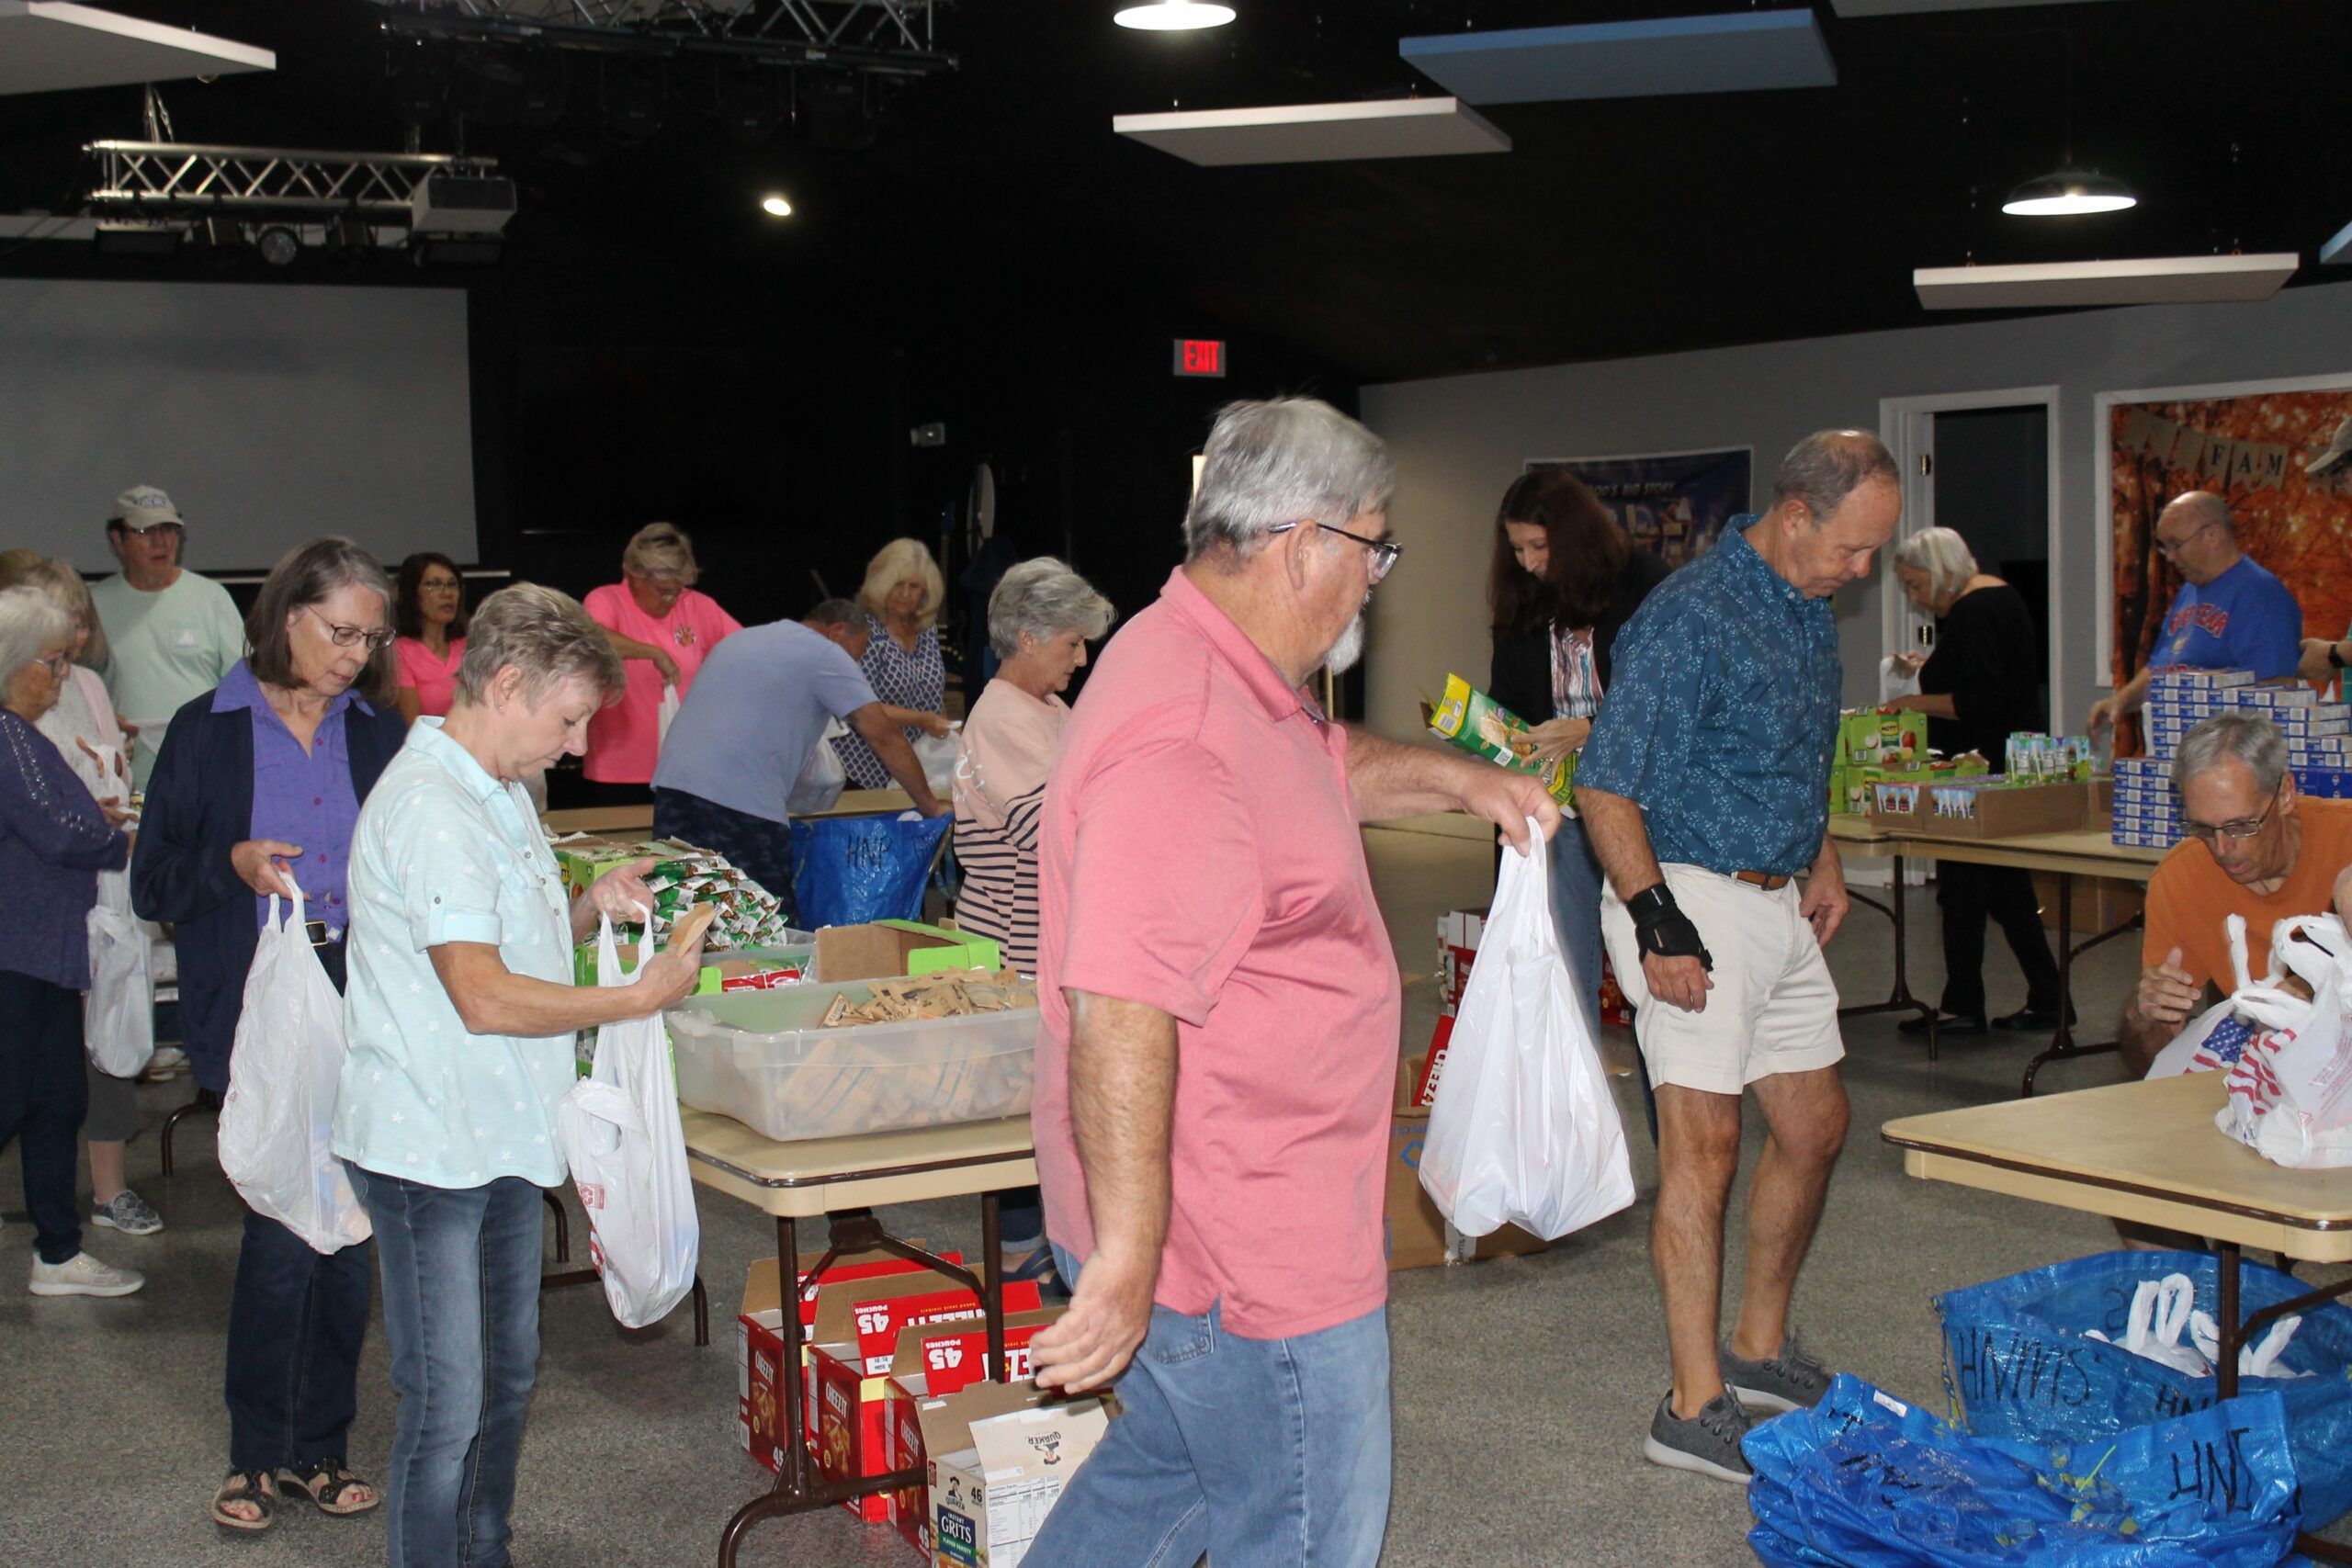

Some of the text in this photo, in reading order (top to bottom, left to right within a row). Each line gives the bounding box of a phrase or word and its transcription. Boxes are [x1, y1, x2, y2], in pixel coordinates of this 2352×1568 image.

[1183, 339, 1220, 373] EXIT
[846, 834, 892, 870] HNP
[857, 1313, 889, 1335] 45
[928, 1347, 963, 1371] 45
[1028, 1431, 1061, 1445] QUAKER
[945, 1495, 966, 1511] QUAKER
[971, 1486, 982, 1503] 46
[919, 1524, 930, 1550] 45
[941, 1516, 972, 1544] GRITS
